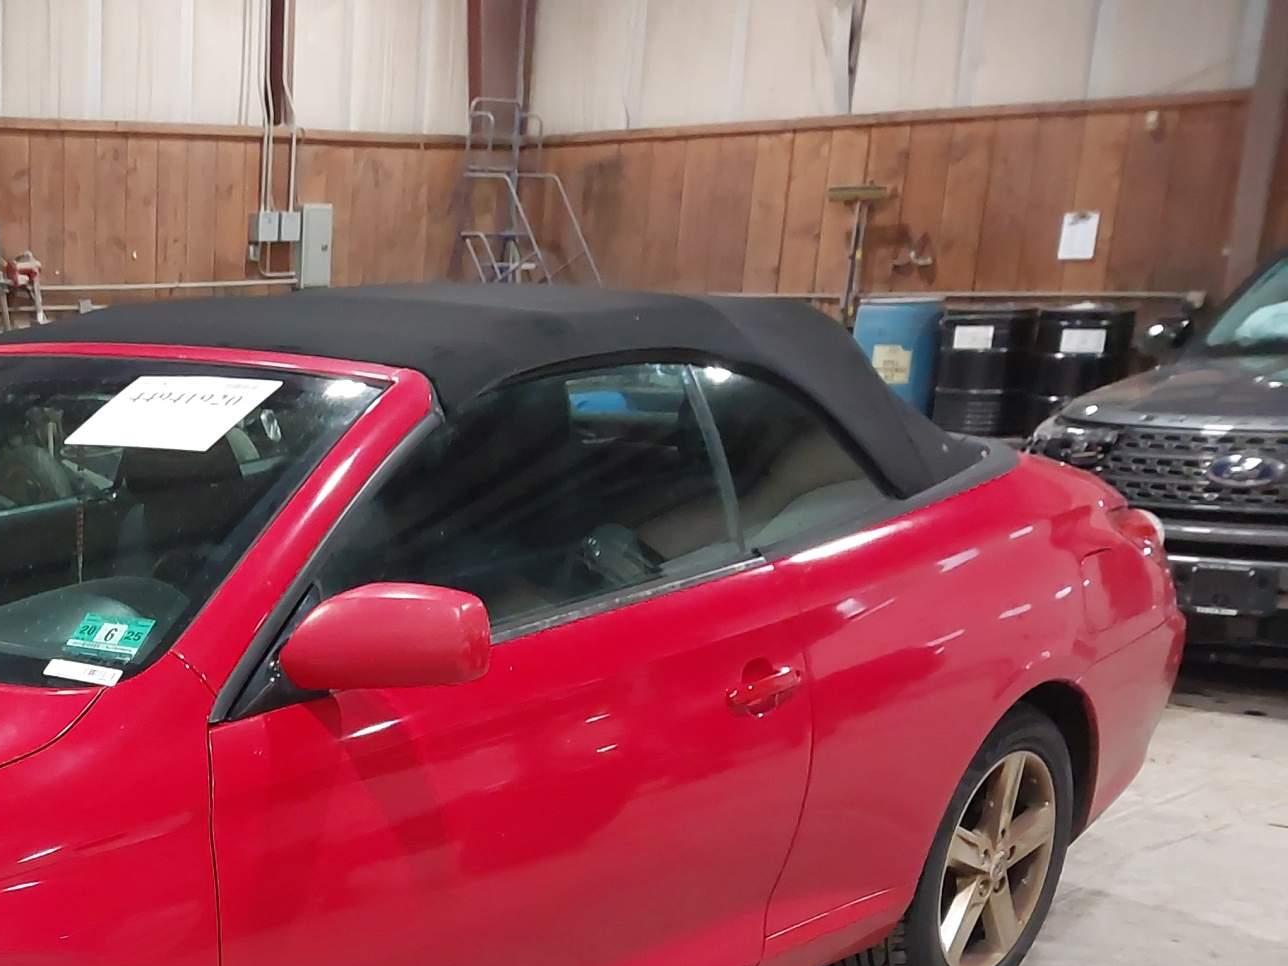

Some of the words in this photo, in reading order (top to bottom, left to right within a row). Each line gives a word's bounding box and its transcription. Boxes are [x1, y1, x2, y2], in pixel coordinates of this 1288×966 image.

[79, 624, 96, 635] 20
[104, 627, 118, 642] 6
[124, 631, 143, 641] 25
